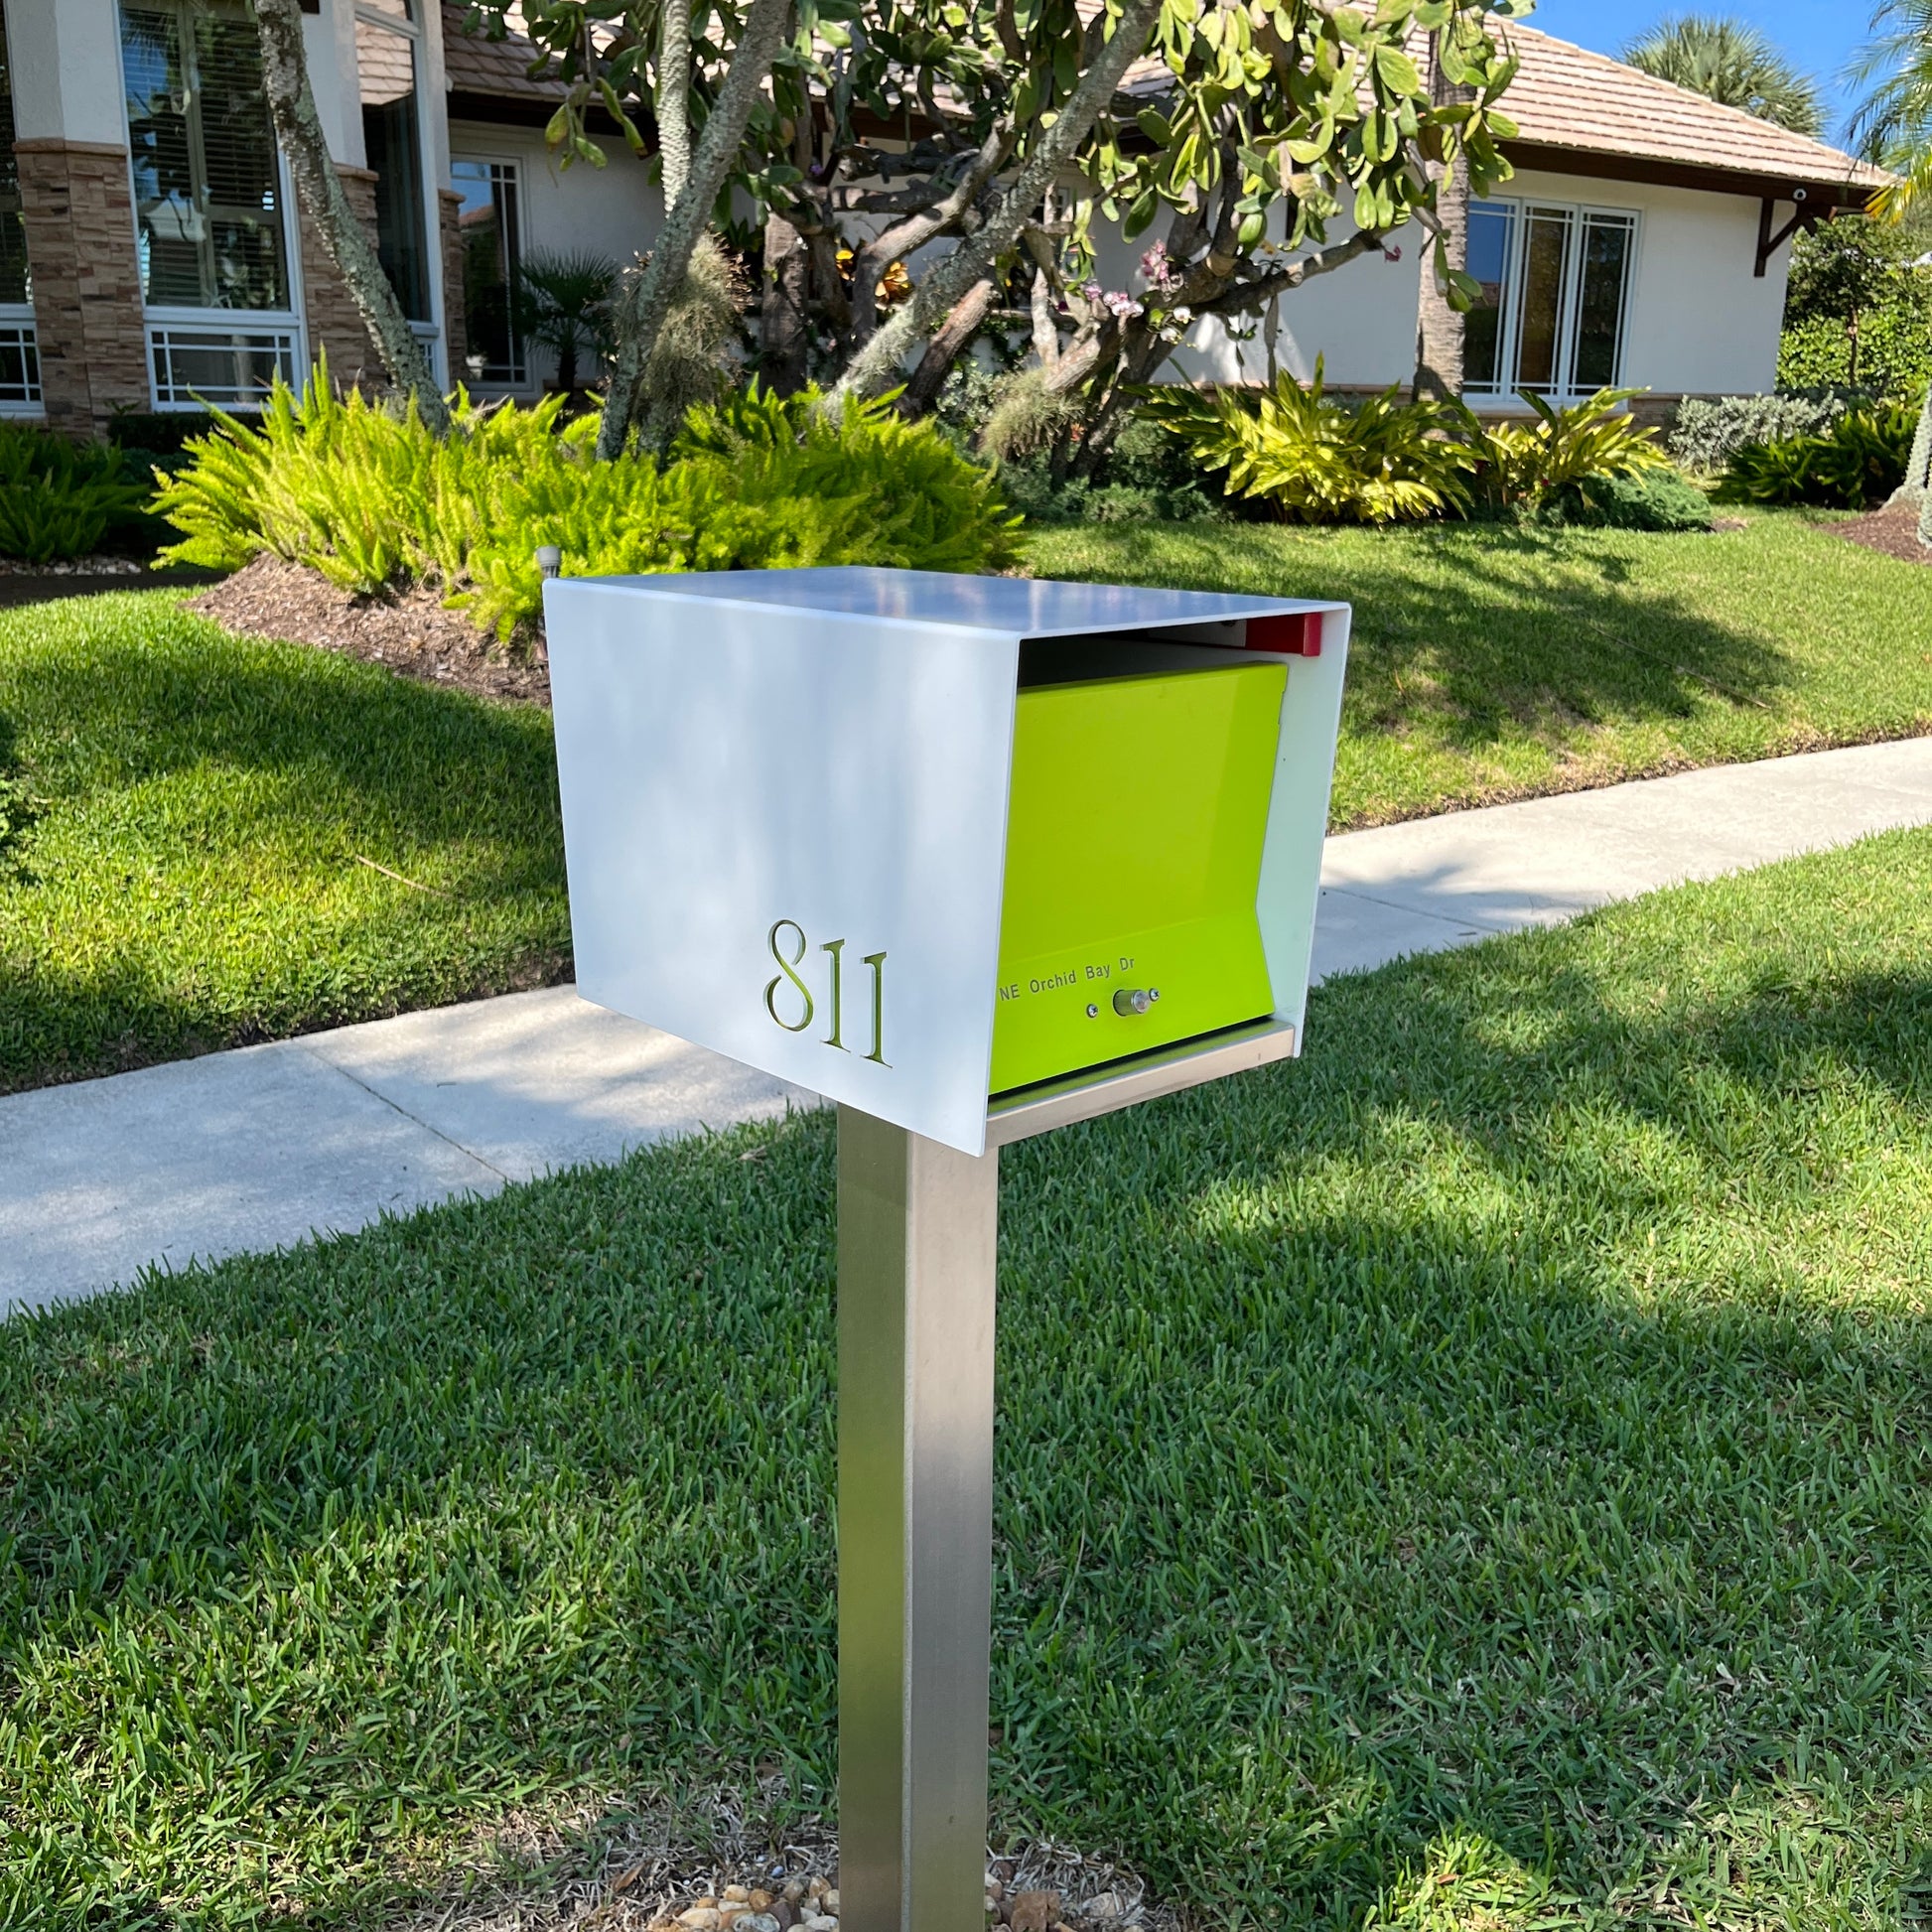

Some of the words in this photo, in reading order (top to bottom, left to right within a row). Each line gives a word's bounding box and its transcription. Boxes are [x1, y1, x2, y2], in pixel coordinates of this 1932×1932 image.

[762, 919, 894, 1068] 811
[999, 984, 1021, 1001] NE
[1030, 970, 1077, 994] Orchid
[1085, 964, 1111, 980] Bay
[1119, 957, 1135, 971] Dr
